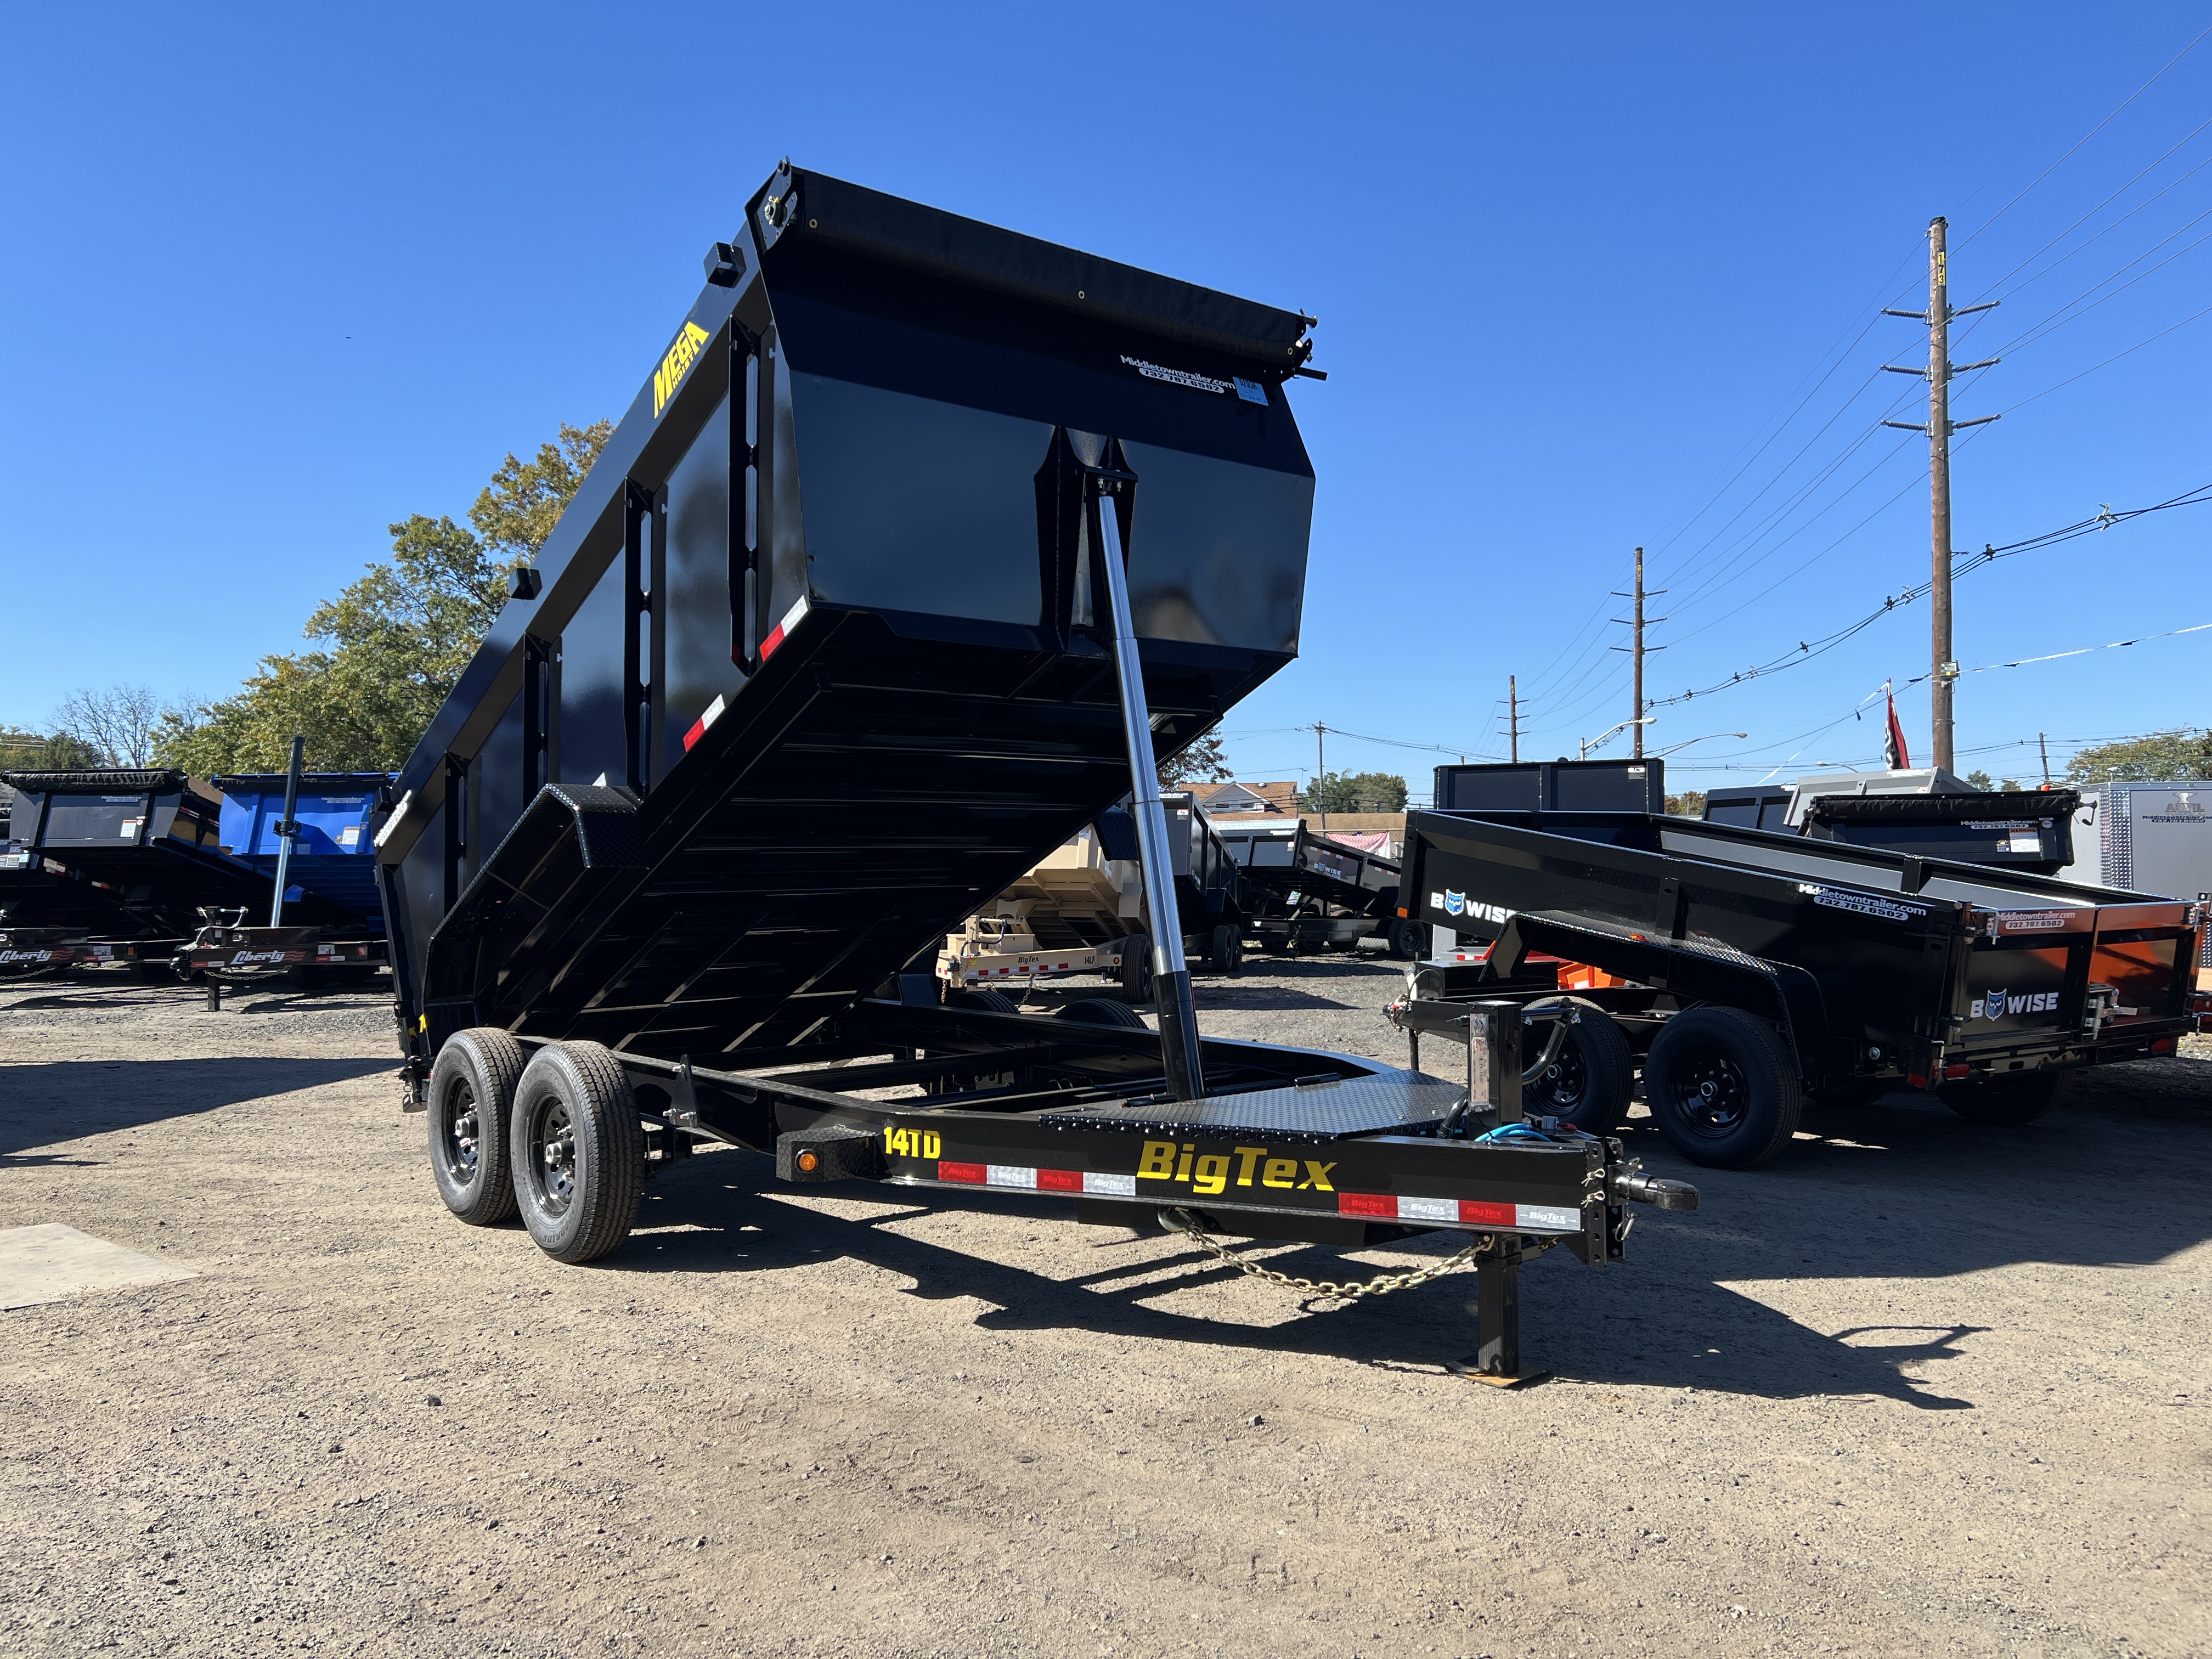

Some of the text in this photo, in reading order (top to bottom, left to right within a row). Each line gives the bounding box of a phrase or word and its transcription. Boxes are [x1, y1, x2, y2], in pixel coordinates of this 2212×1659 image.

[653, 321, 710, 419] MEGA
[672, 351, 694, 390] HOIST
[1120, 355, 1236, 390] Middletowntrailer.com
[2165, 803, 2205, 812] ANVIL
[1798, 883, 1927, 916] Middletowntrailer.com
[1818, 897, 1904, 919] 732.787.6502
[0, 950, 53, 963] Liberty
[230, 950, 286, 965] Liberty
[1018, 956, 1040, 964] BigTex
[883, 1126, 940, 1159] 14TD
[947, 1167, 977, 1177] BigTex
[1136, 1141, 1338, 1194] BigTex
[997, 1171, 1026, 1180] BigTex
[1043, 1175, 1072, 1184] BigTex
[1094, 1178, 1124, 1187] BigTex
[1351, 1200, 1385, 1209] BigTex
[1410, 1203, 1445, 1212] BigTex
[1466, 1207, 1503, 1216] BigTex
[1529, 1211, 1566, 1221] BigTex
